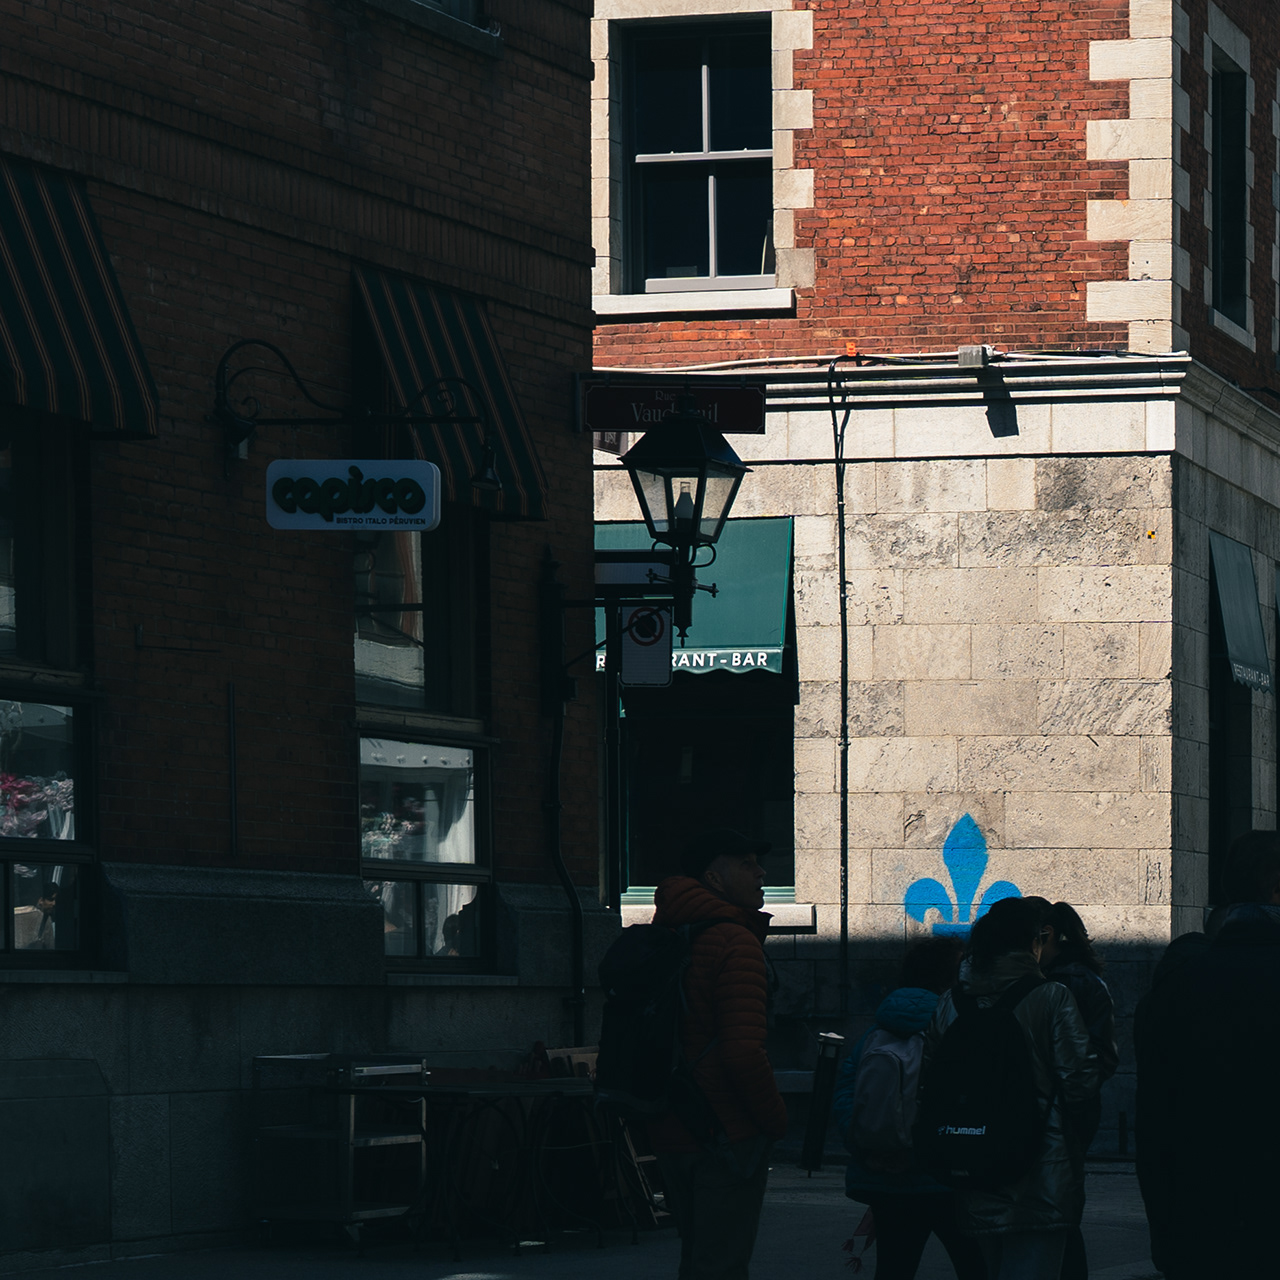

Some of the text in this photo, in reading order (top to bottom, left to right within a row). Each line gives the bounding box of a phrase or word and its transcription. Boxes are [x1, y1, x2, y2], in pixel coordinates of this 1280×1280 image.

[655, 390, 676, 401] Rue
[272, 465, 426, 522] capisco
[389, 516, 426, 525] PÉRUVIEN
[945, 1125, 986, 1135] hummel
